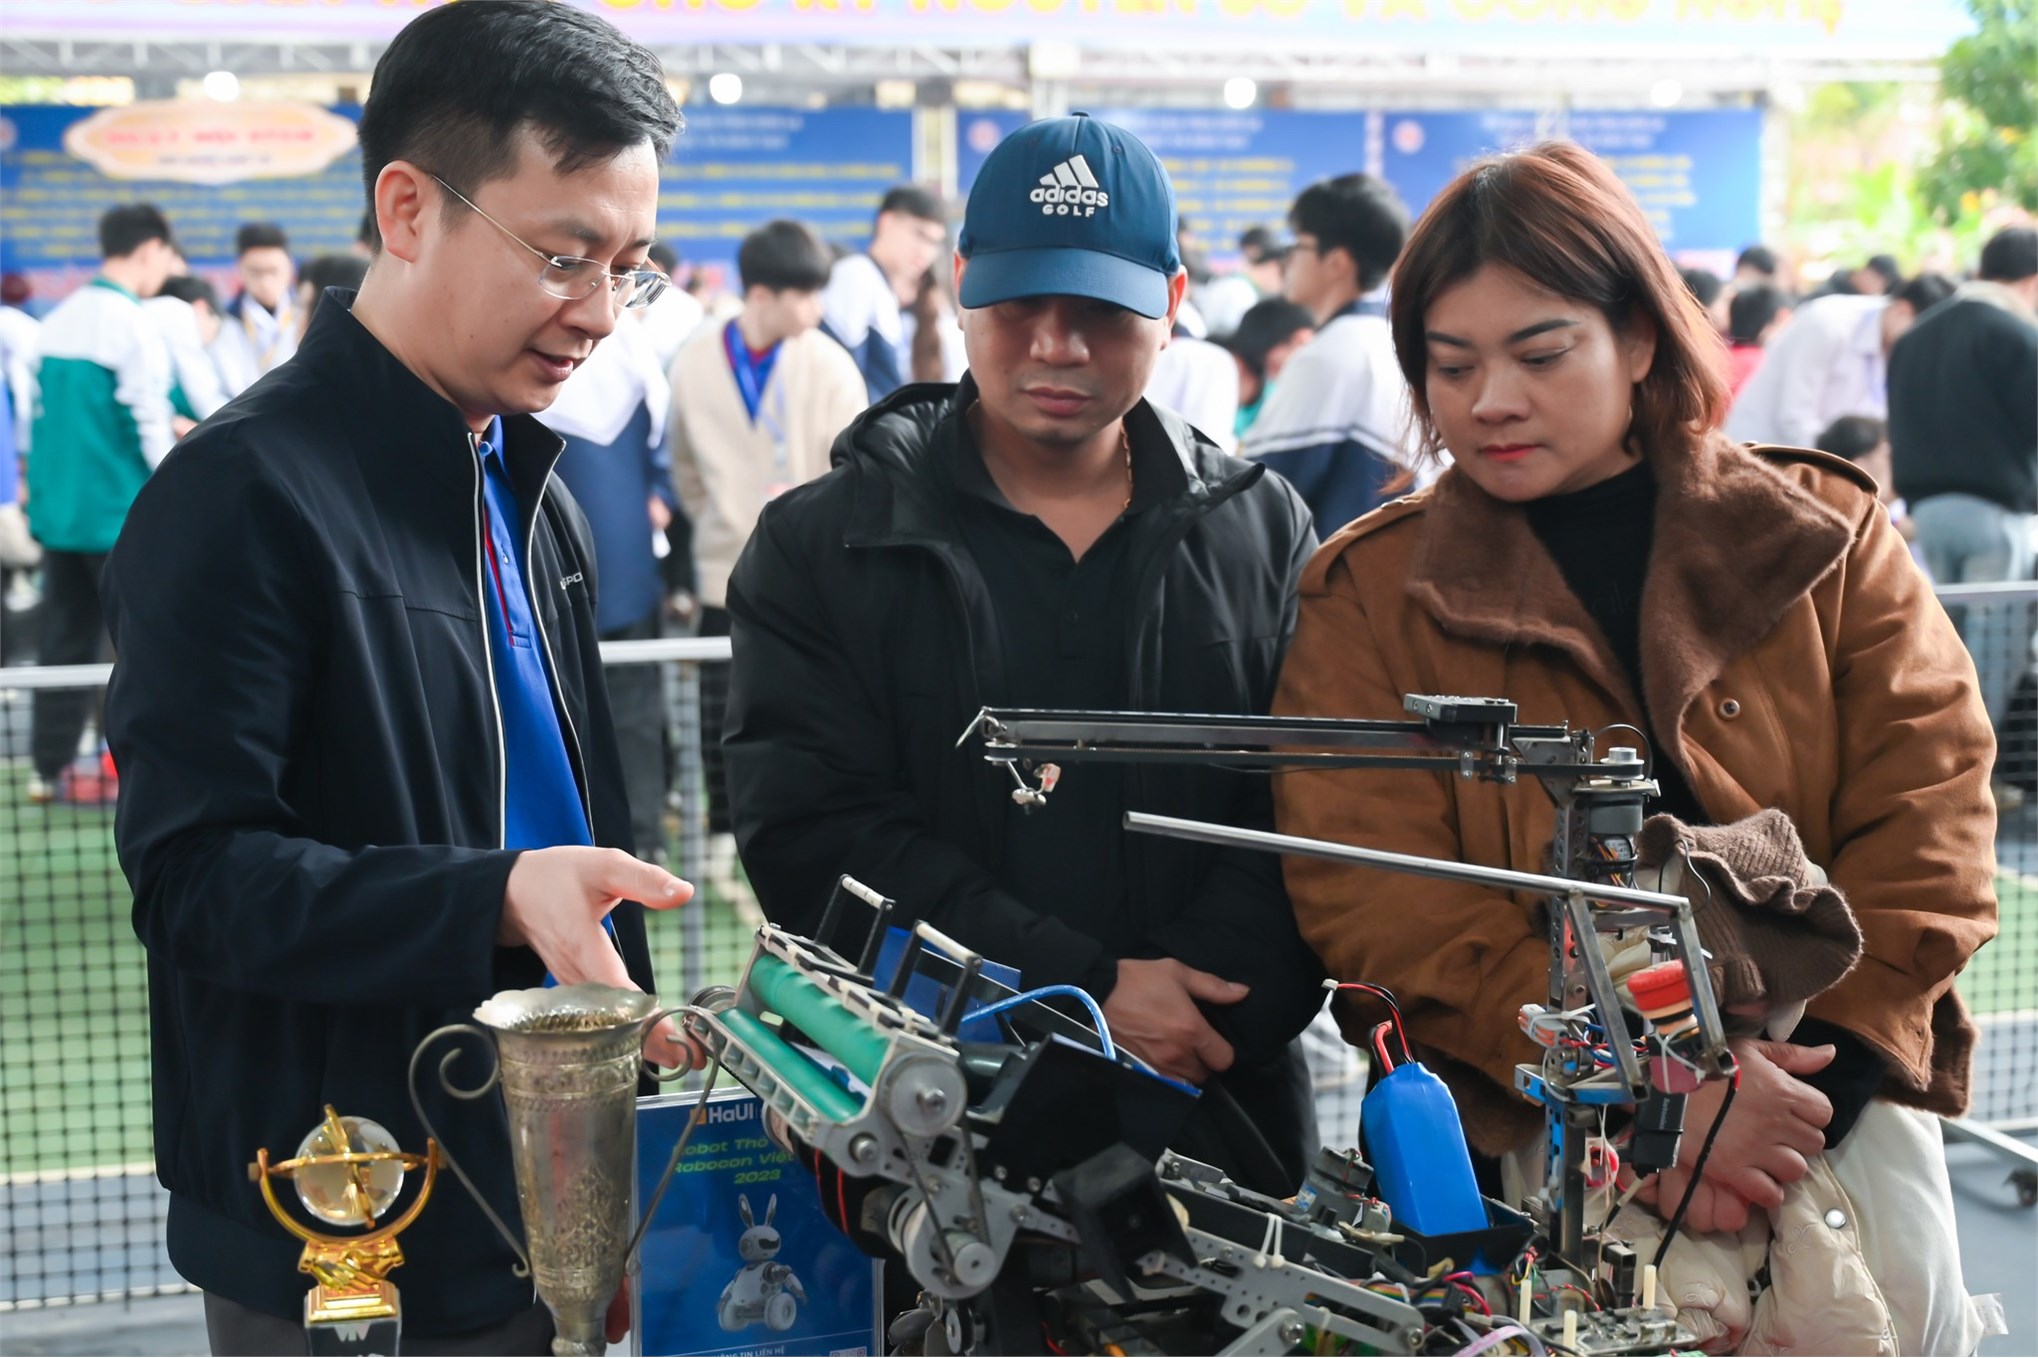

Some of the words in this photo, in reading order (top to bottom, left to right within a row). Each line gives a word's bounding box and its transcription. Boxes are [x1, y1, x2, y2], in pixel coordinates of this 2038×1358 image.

[1029, 184, 1109, 207] adidas
[1042, 204, 1095, 218] GOLF
[673, 1142, 729, 1156] obot
[733, 1169, 782, 1185] 2023
